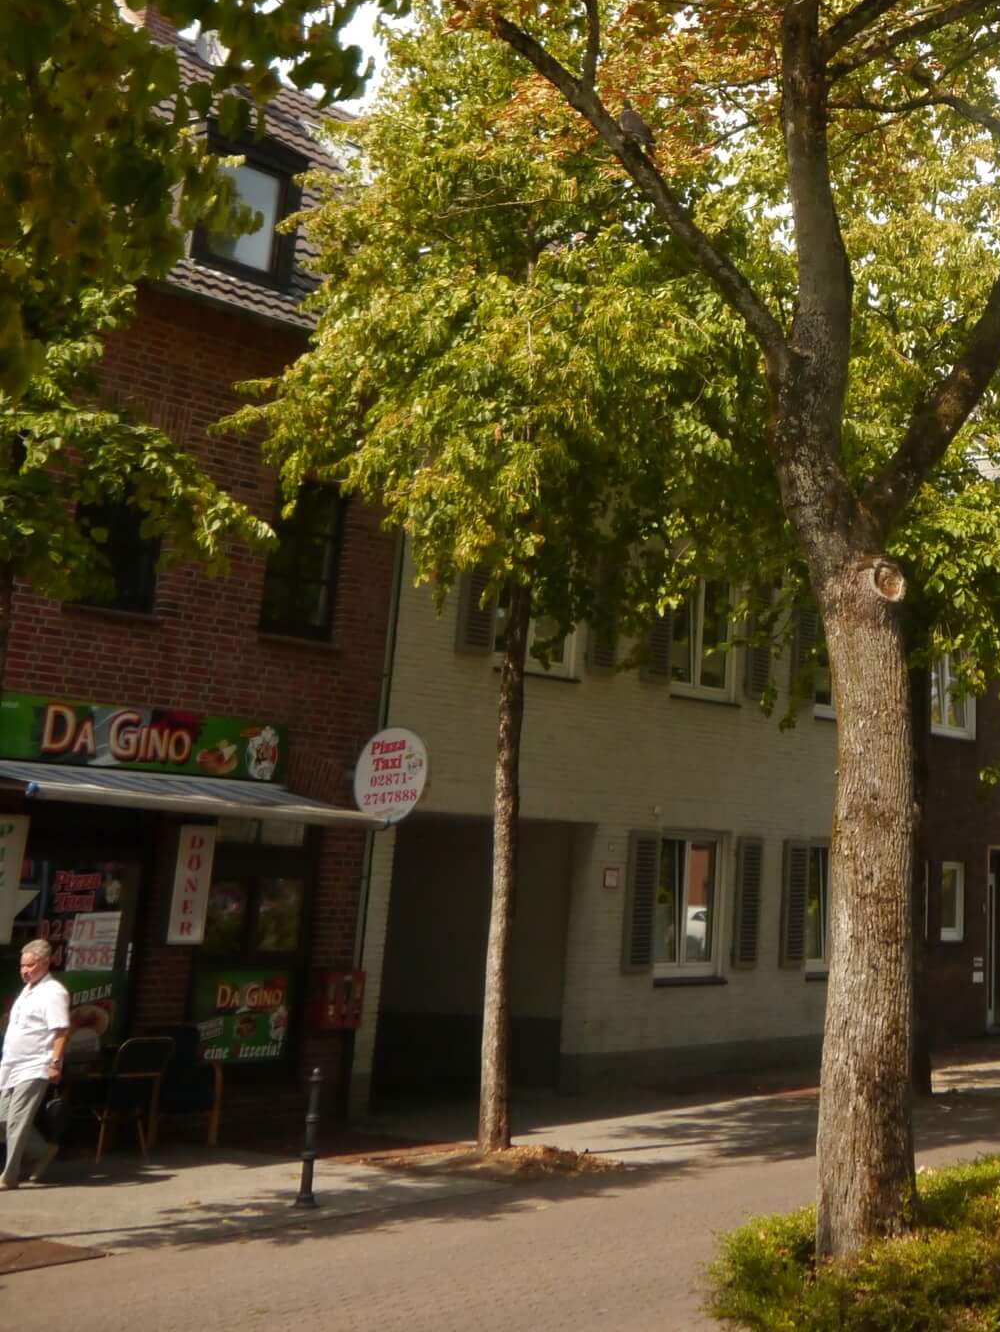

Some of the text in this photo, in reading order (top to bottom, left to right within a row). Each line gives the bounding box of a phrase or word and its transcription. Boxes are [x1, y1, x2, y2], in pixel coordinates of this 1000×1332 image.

[109, 709, 192, 764] GINO
[371, 740, 405, 755] Pizza
[373, 755, 402, 771] Taxi
[370, 772, 414, 787] 02871-
[363, 789, 417, 805] 2747888
